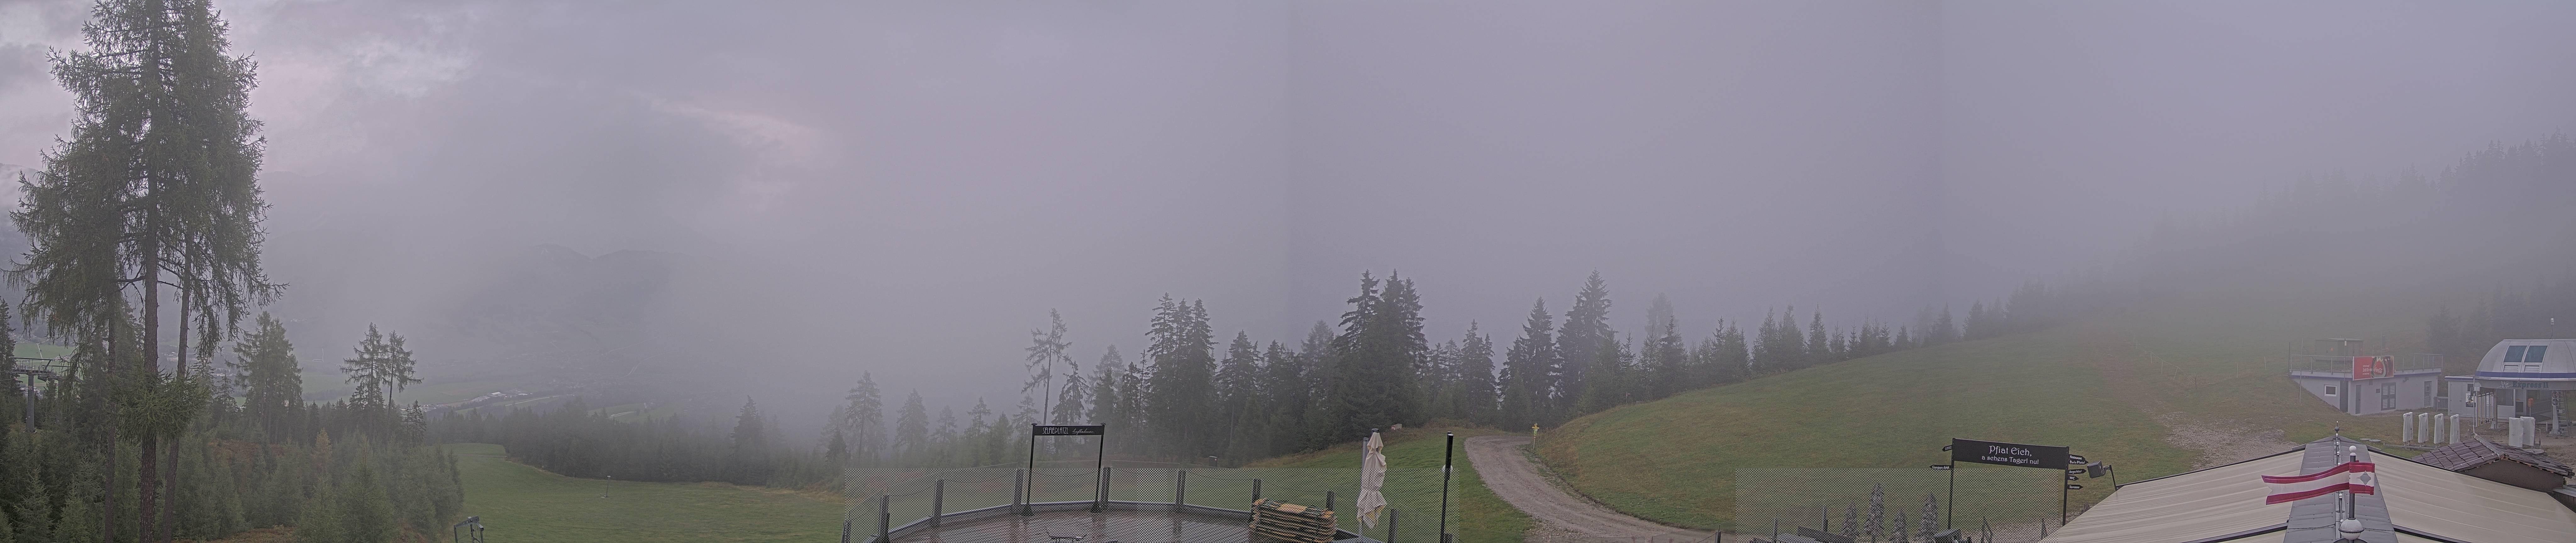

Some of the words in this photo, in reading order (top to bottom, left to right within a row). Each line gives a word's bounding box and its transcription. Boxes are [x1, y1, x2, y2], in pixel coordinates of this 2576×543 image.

[2513, 381, 2541, 389] Express
[1989, 445, 2008, 455] Pfiat
[2011, 447, 2032, 457] Eich,
